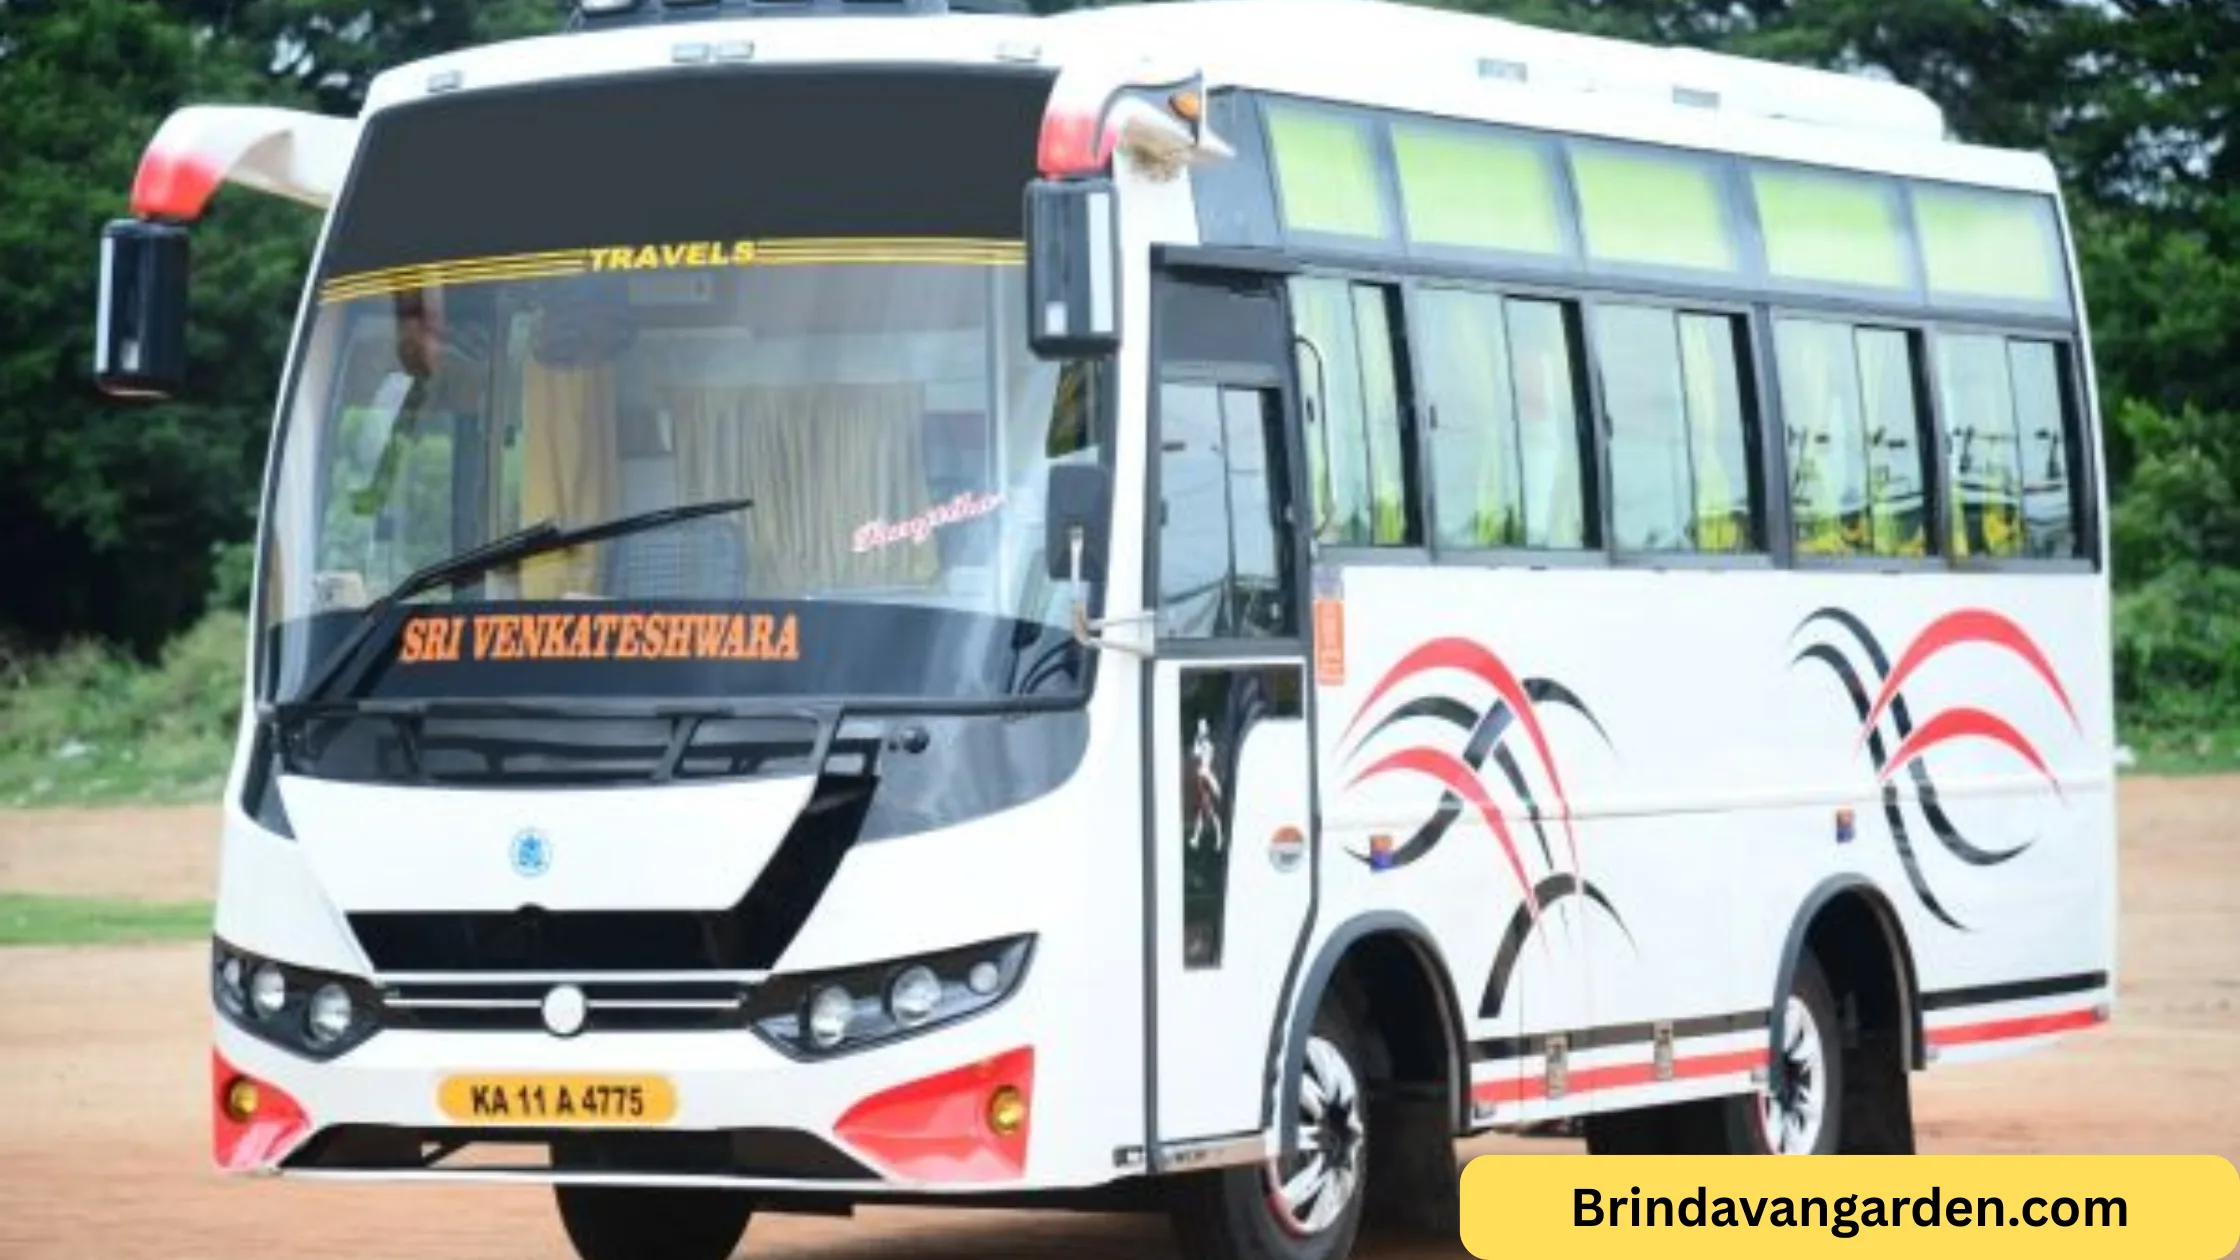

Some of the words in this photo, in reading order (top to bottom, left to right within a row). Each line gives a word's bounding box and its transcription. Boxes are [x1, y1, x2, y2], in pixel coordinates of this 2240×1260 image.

[589, 240, 756, 272] TRAVELS
[401, 616, 464, 662] SRI
[471, 612, 799, 661] VENKATESHWARA
[471, 1085, 509, 1115] KA
[518, 1085, 547, 1115] 11
[556, 1085, 576, 1115] A
[582, 1085, 645, 1116] 4775
